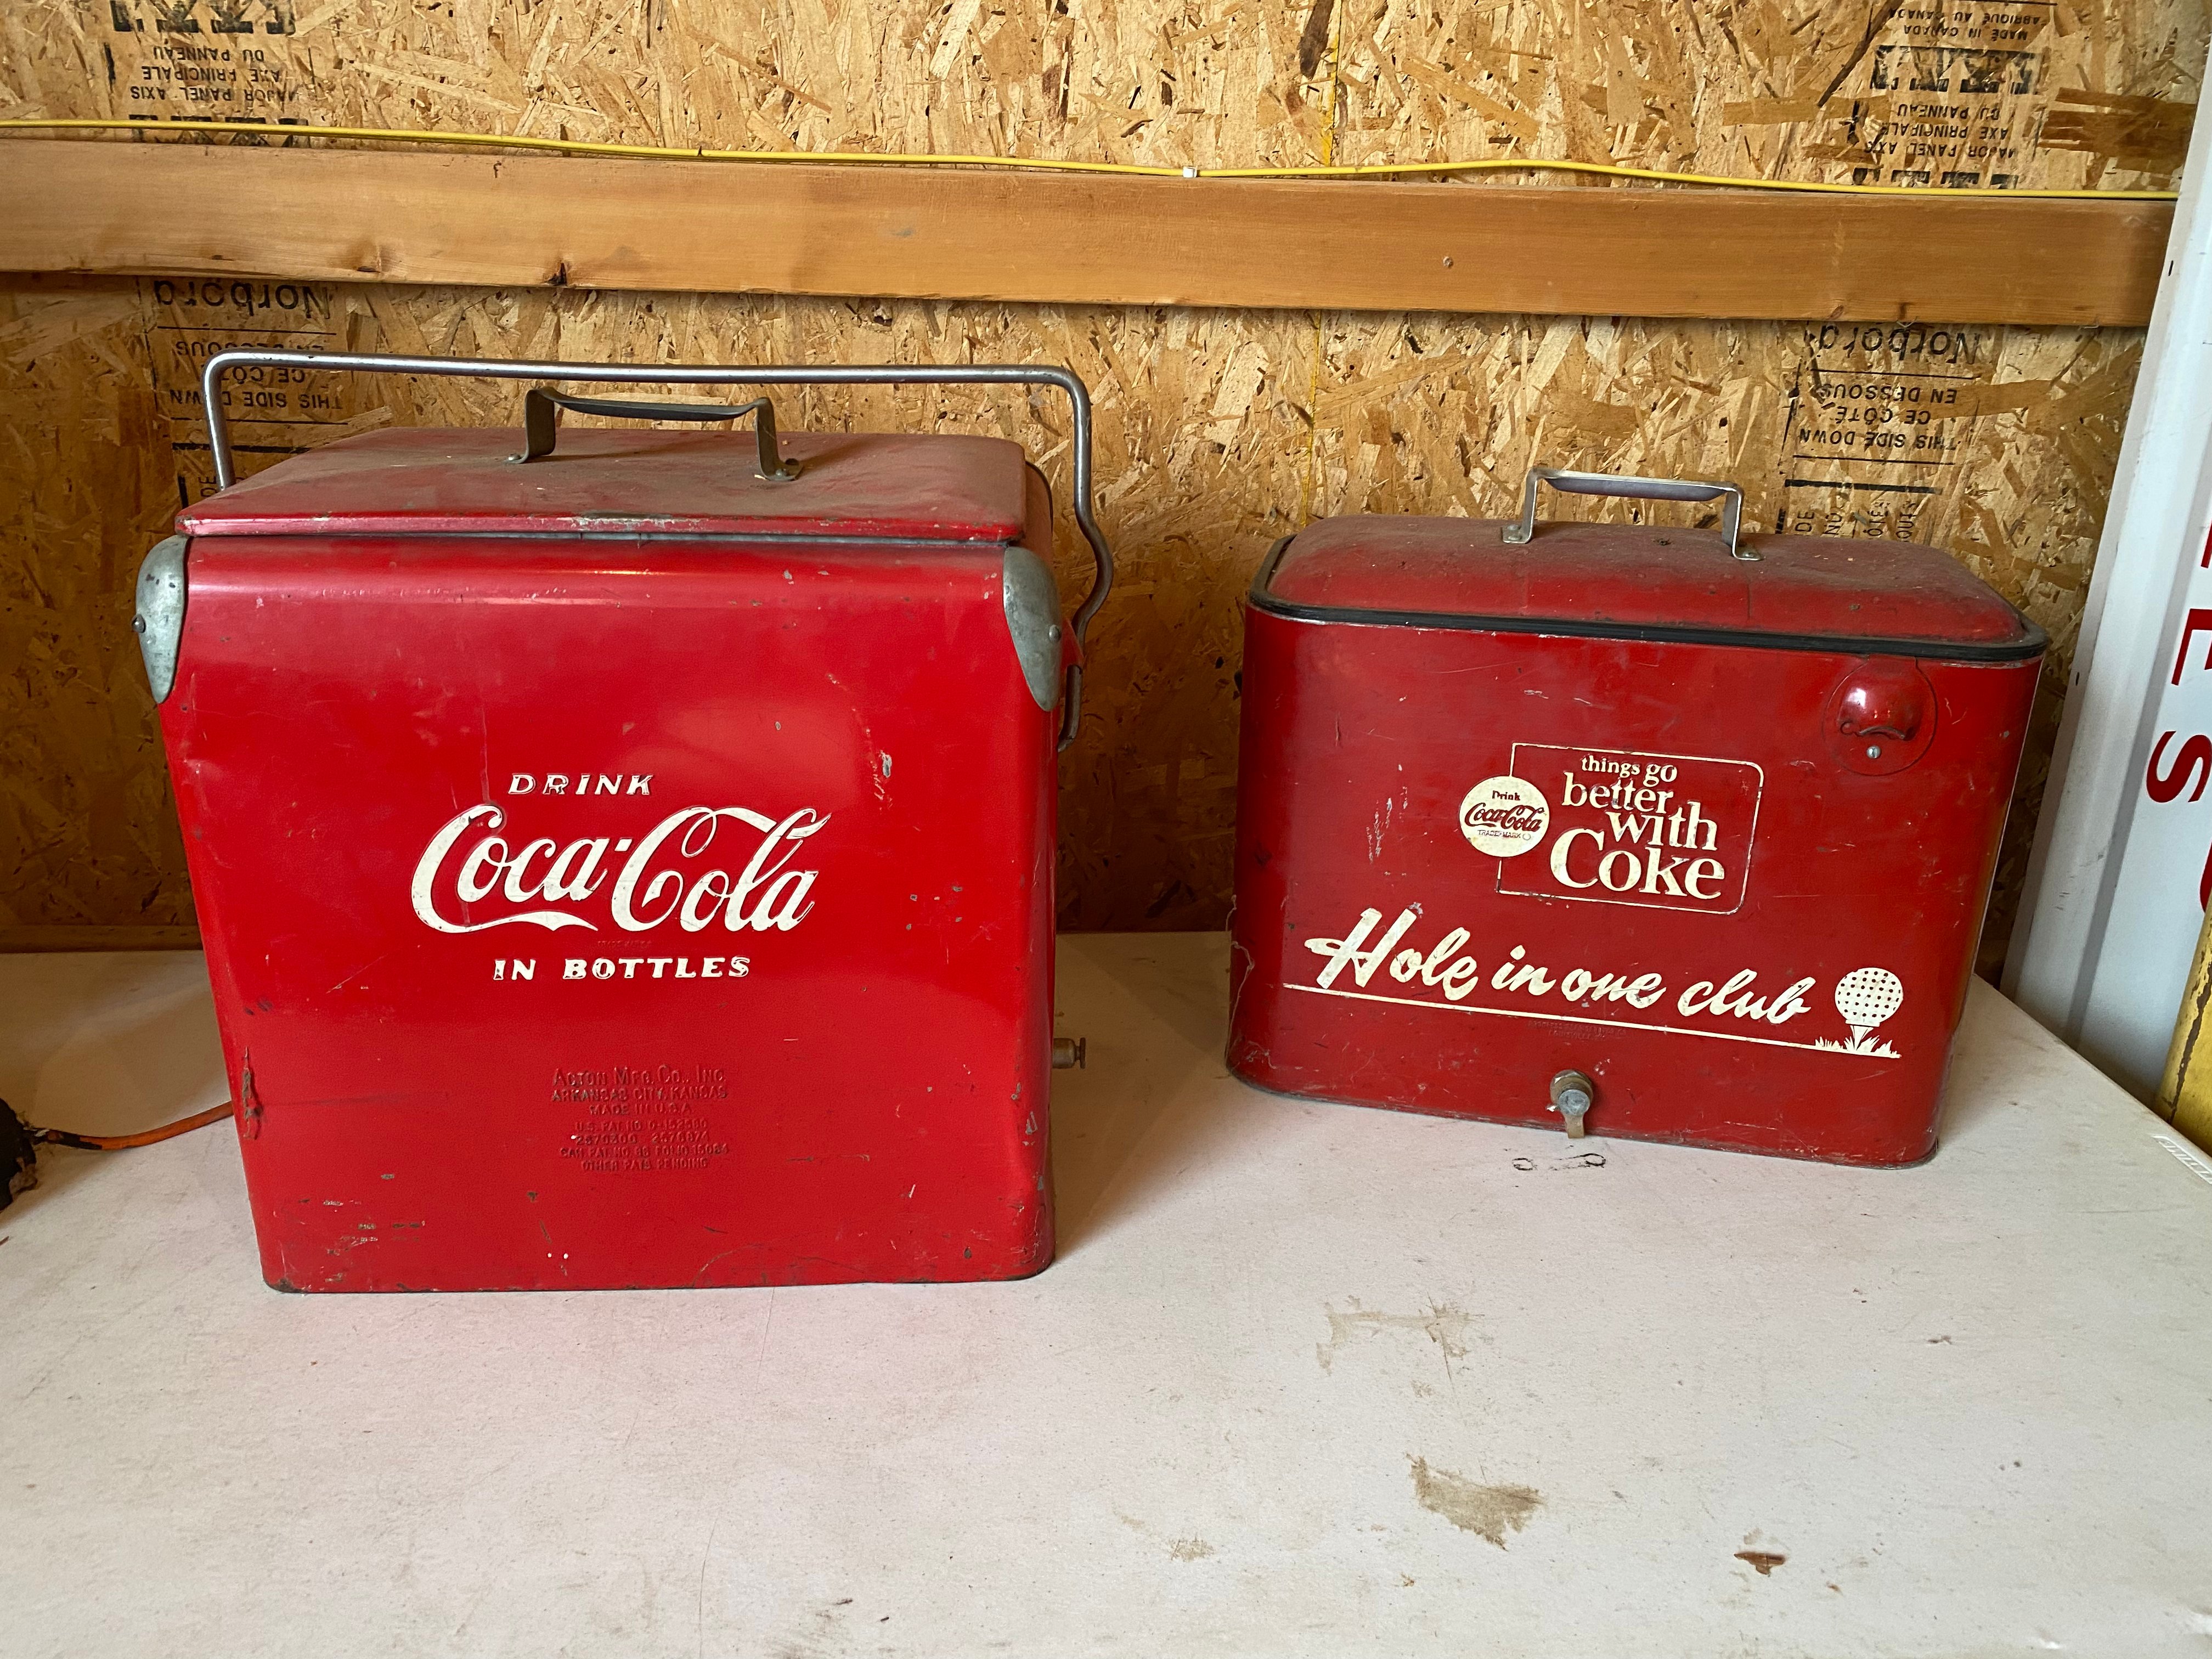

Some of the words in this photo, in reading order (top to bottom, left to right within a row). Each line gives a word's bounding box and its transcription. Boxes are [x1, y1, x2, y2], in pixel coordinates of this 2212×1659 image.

[1904, 24, 1960, 38] CANADA
[1968, 29, 1982, 38] IN
[154, 46, 230, 61] PANNEAU
[242, 49, 264, 63] DU
[130, 86, 166, 100] AXIS
[180, 86, 232, 101] PANEL
[1898, 103, 1968, 120] PANNEAU
[1980, 127, 2009, 141] AXE
[278, 368, 306, 383] CE
[244, 391, 287, 408] SIDE
[298, 393, 343, 409] THIS
[1930, 388, 1958, 404] EN
[1835, 405, 1893, 425] CÔTÉ
[1905, 410, 1932, 425] CE
[1799, 428, 1855, 446] DOWN
[1865, 431, 1906, 448] SIDE
[1916, 434, 1957, 450] THIS
[1581, 755, 1641, 778] things
[1645, 763, 1678, 788] go
[507, 773, 655, 796] DRINK
[1562, 770, 1674, 814] better
[1492, 790, 1521, 801] Drink
[1464, 802, 1545, 832] Coca-Cola
[1604, 799, 1719, 851] with
[410, 803, 833, 934] Coca-Cola
[1549, 827, 1725, 900] Coke
[493, 958, 537, 981] IN
[562, 955, 752, 980] BOTTLES
[1303, 907, 1480, 1002] Hole
[1491, 944, 1557, 995] in
[1561, 967, 1668, 1009] one
[1676, 967, 1816, 1025] club
[589, 1103, 629, 1116] MADE
[634, 1103, 651, 1115] IN
